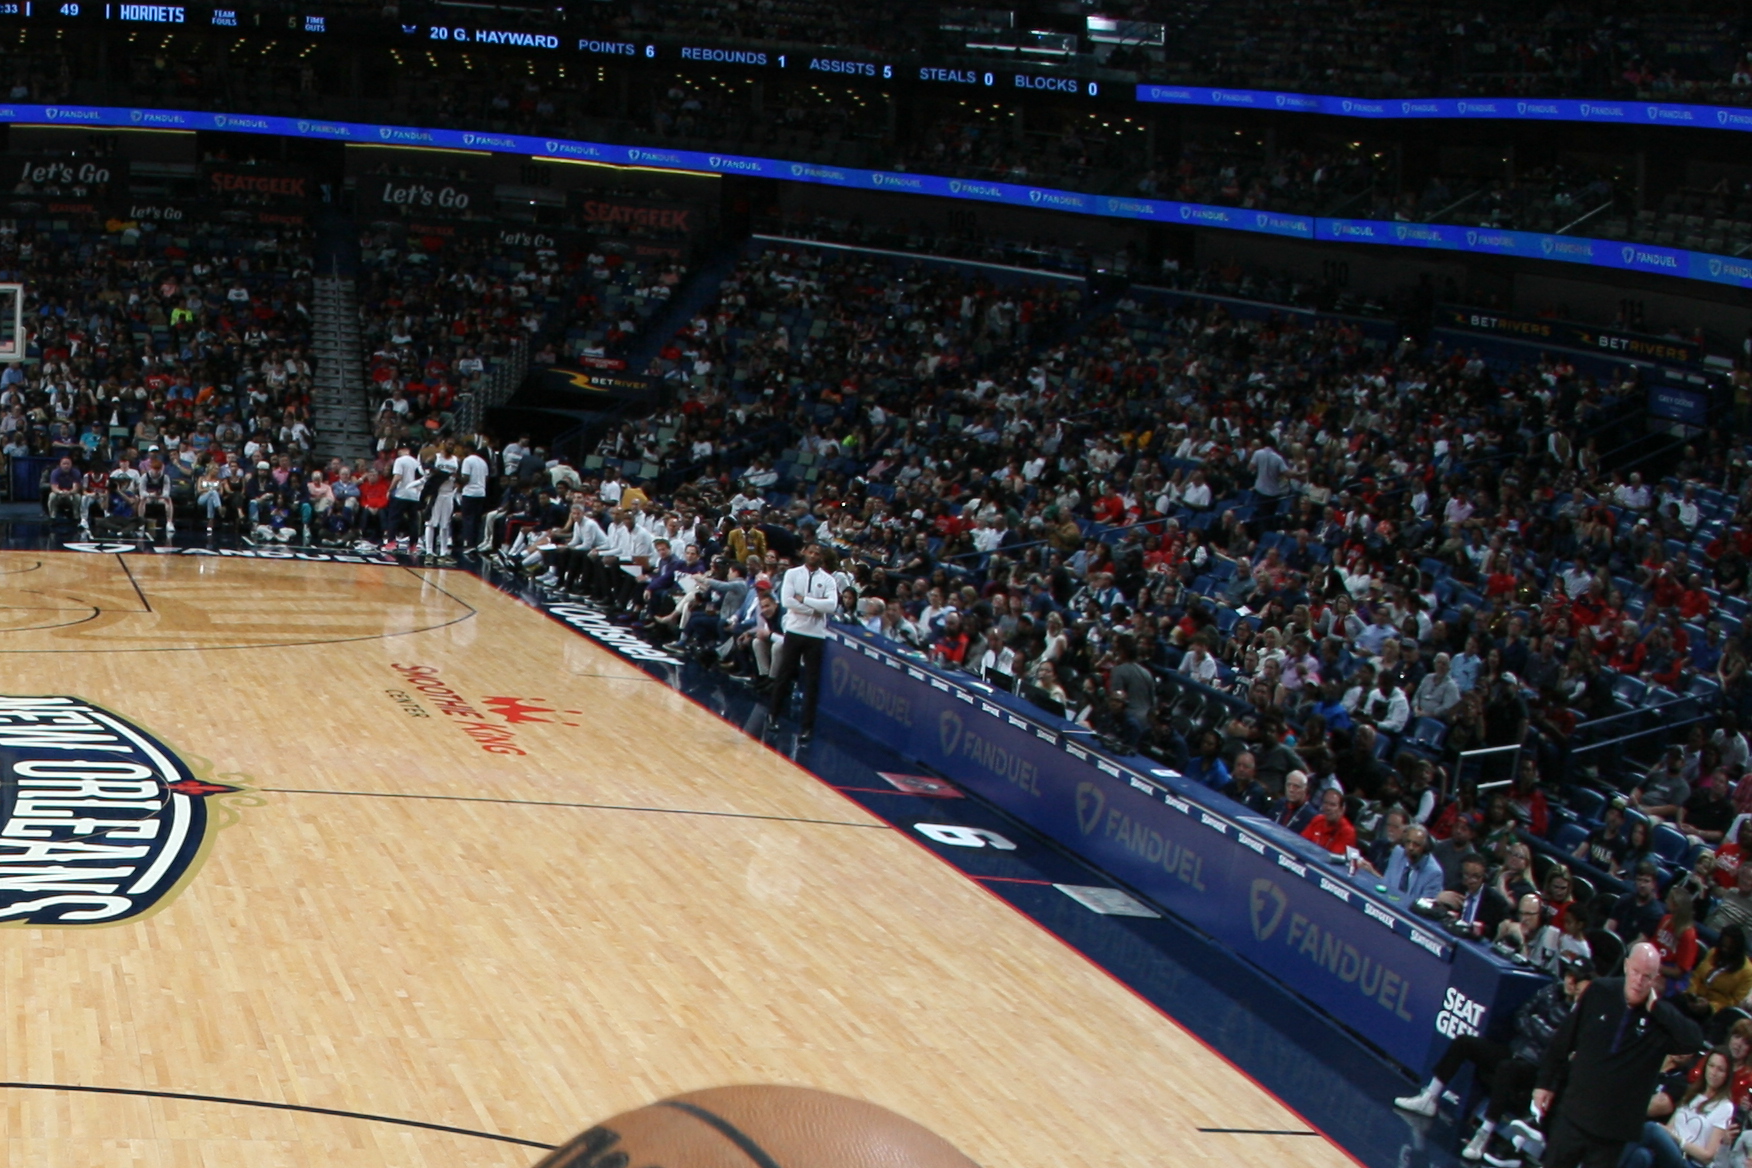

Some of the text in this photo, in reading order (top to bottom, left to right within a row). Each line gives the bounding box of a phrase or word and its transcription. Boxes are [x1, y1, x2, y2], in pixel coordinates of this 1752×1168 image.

[59, 3, 79, 16] 49
[120, 4, 185, 23] HORNETS
[211, 17, 238, 26] FOULS
[213, 9, 236, 18] TEAM
[305, 16, 326, 24] TIME
[430, 26, 1098, 96] 20 G. HAYWARD POINTS 6 REBOUNDS 1 ASSISTS 5 STEALS 0 BLOCKS 0
[393, 130, 434, 142] FANDUEL
[21, 162, 110, 185] Let's Go
[210, 171, 308, 198] SEATGEEK
[382, 182, 470, 210] Let's Go
[163, 206, 183, 221] Go
[582, 198, 691, 232] SEATGEEK
[1637, 251, 1678, 268] FANDUEL
[1471, 314, 1551, 337] BETRIVERS
[1599, 335, 1688, 361] BETRIVERS
[591, 376, 648, 390] BETRIVER
[153, 546, 399, 566] FANDUEL
[390, 662, 528, 756] SMOOTHIE KING
[848, 673, 913, 727] FANDUEL
[963, 731, 1042, 797] FANDUEL
[1105, 807, 1207, 894] FANDUEL
[1278, 854, 1306, 878] SEATGEEK
[1320, 877, 1349, 903] SEATGEEK
[1364, 902, 1395, 929] SEATGEEK
[1410, 929, 1443, 957] SEATGEEK
[1286, 913, 1412, 1022] FANDUEL
[1443, 986, 1487, 1029] SEAT
